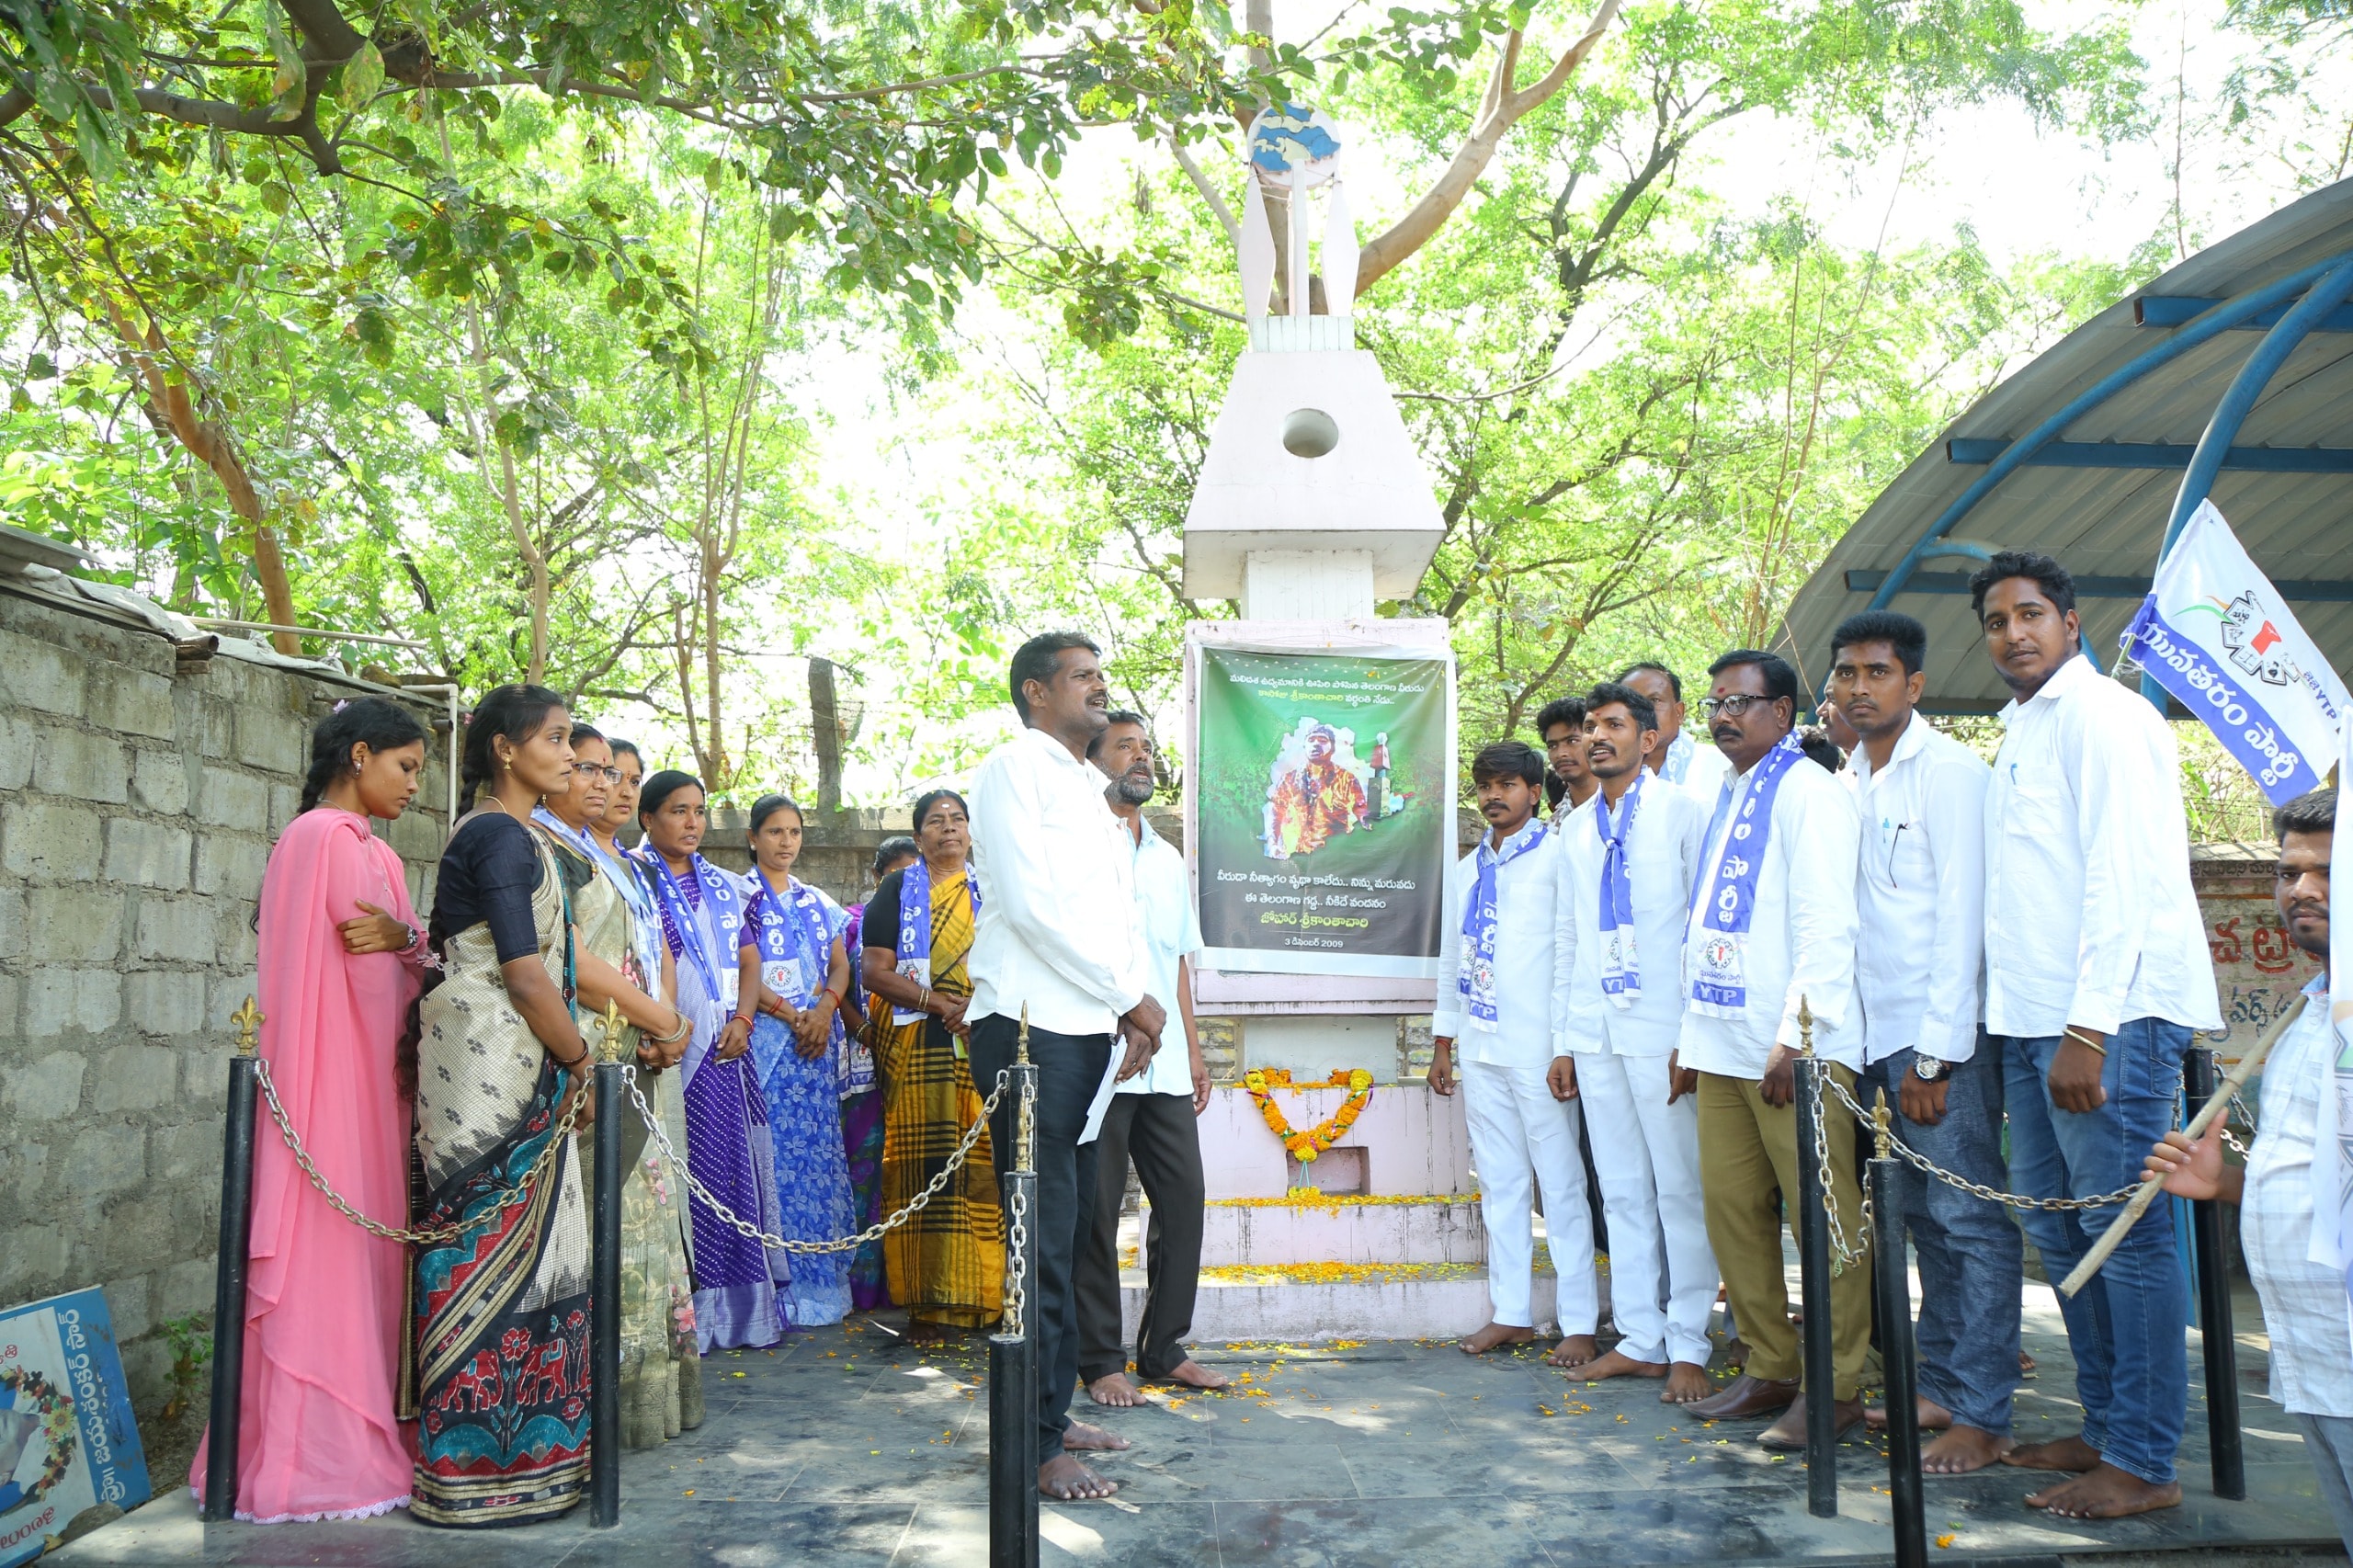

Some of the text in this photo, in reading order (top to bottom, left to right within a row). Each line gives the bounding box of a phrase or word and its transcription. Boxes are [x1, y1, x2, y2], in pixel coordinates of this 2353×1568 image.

[1360, 682, 1396, 691] తెలంగాణ
[2141, 622, 2299, 787] యువతరం పార్టీ
[2315, 689, 2337, 720] YTP
[1217, 869, 1247, 881] వీరుడా
[1350, 877, 1374, 892] నిన్ను
[1374, 878, 1415, 890] మరువదు
[1718, 855, 1749, 924] పార్టీ
[1245, 892, 1257, 903] ఈ
[1259, 892, 1302, 905] తెలంగాణ
[1349, 897, 1387, 909] వందనం
[1321, 940, 1344, 949] 2009
[1699, 984, 1737, 1003] YTP
[57, 1308, 85, 1350] సార్
[67, 1353, 111, 1464] జయశంకర్
